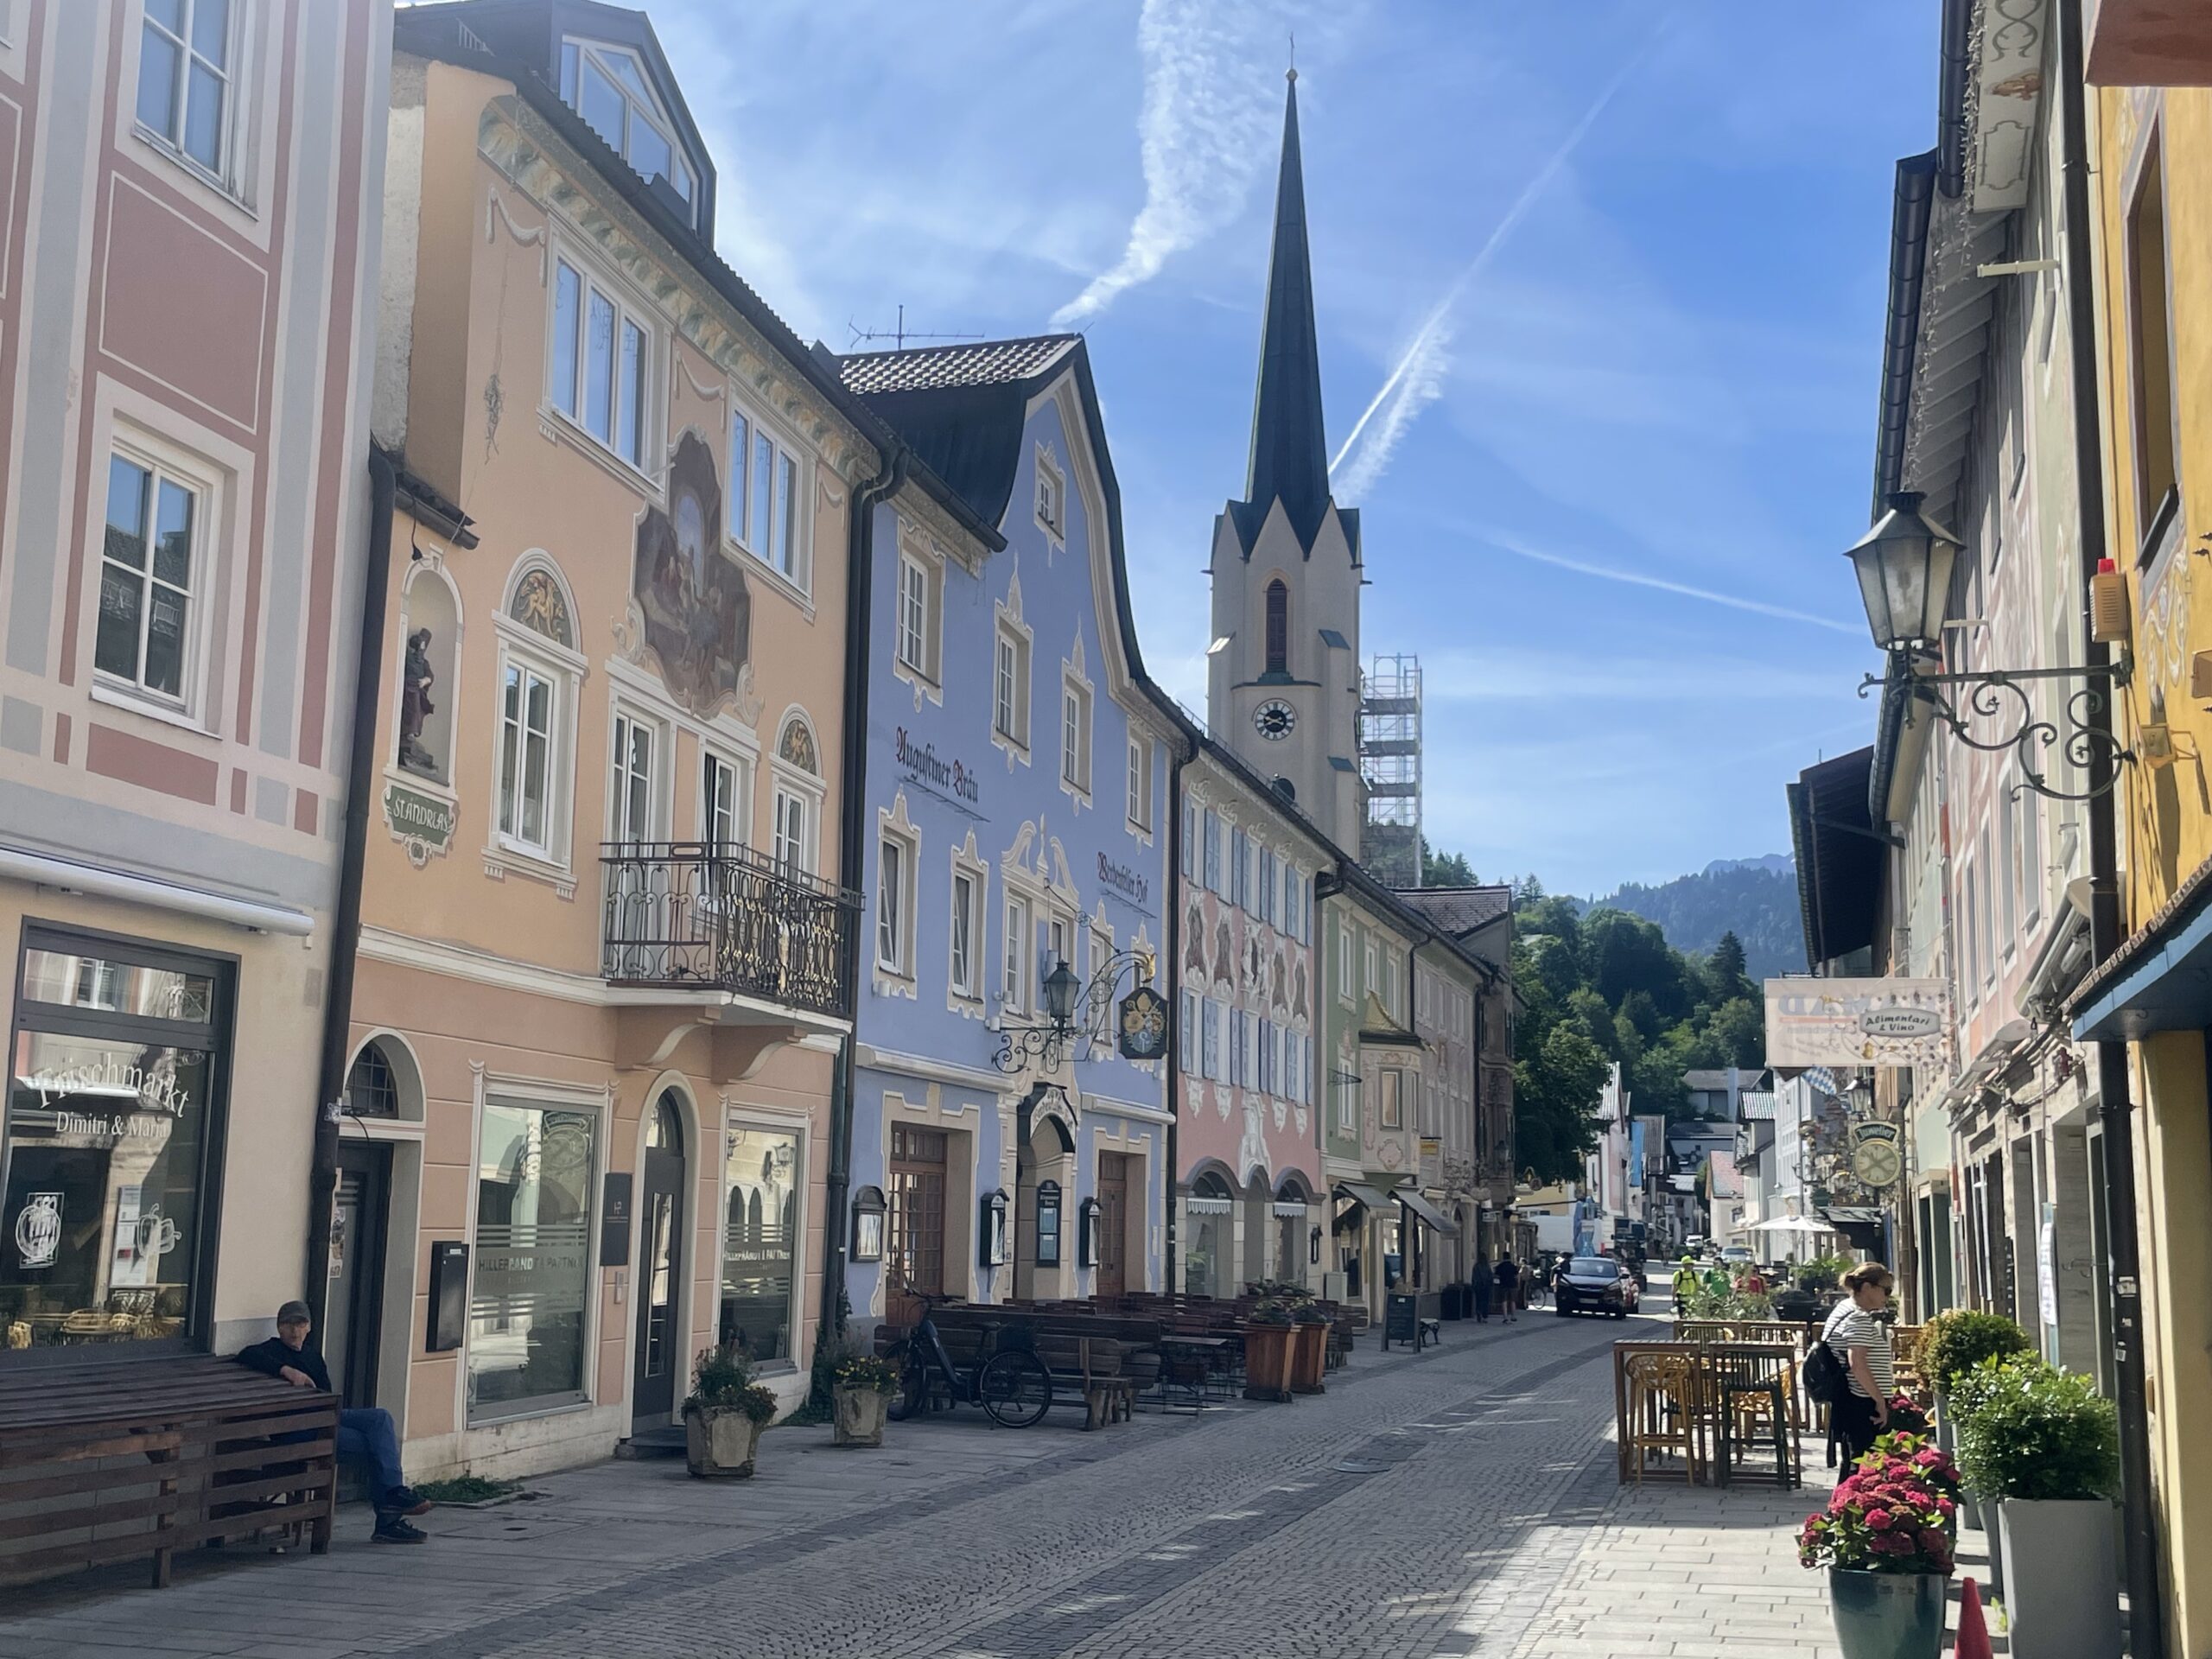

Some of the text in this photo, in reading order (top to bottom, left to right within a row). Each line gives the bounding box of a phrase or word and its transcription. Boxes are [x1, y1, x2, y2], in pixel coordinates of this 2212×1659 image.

[896, 726, 951, 790] Augustiner
[1866, 1014, 1930, 1027] Alimentari
[35, 1052, 189, 1118] Frischmarkt
[55, 1111, 167, 1137] Dimitri & Maria
[1857, 1125, 1895, 1141] Juwelier
